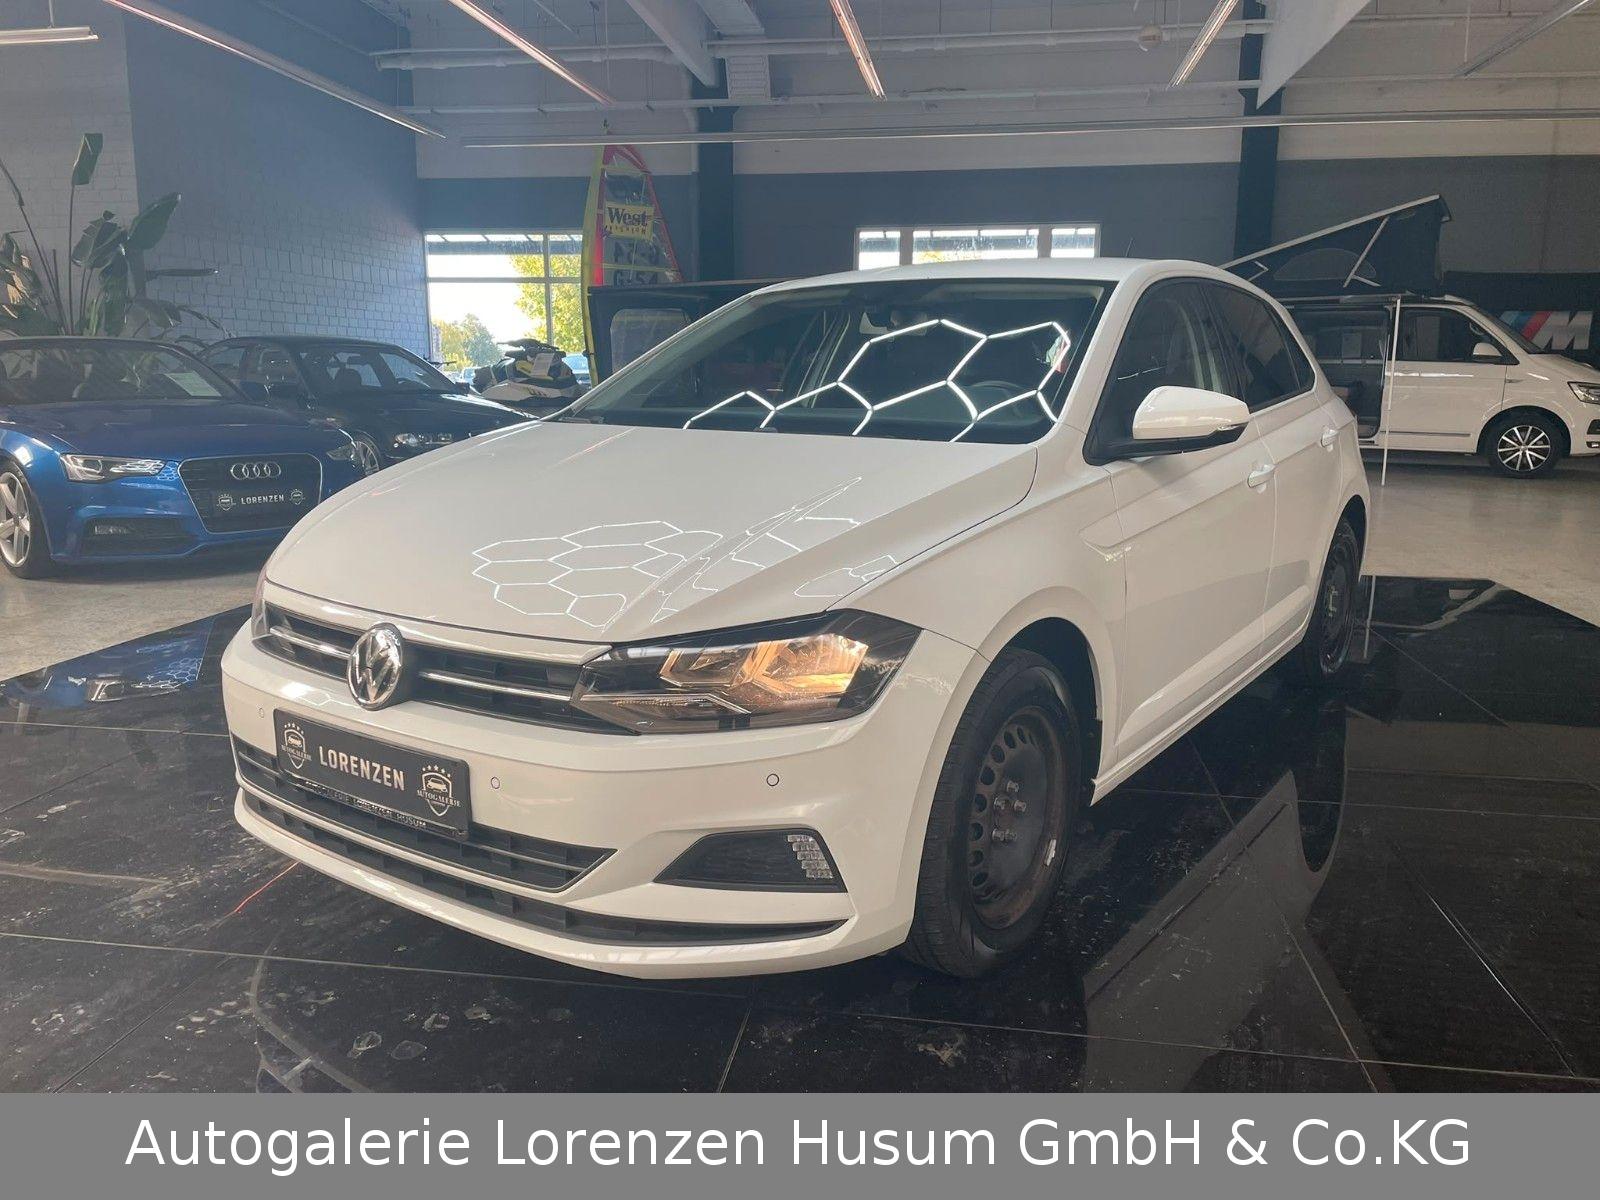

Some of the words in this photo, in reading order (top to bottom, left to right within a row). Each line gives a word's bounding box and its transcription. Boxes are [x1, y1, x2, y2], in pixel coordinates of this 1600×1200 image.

[607, 206, 648, 227] West
[240, 494, 285, 505] LORENZEN
[318, 745, 406, 791] LORENZEN
[416, 788, 462, 808] AUTOGALERIE
